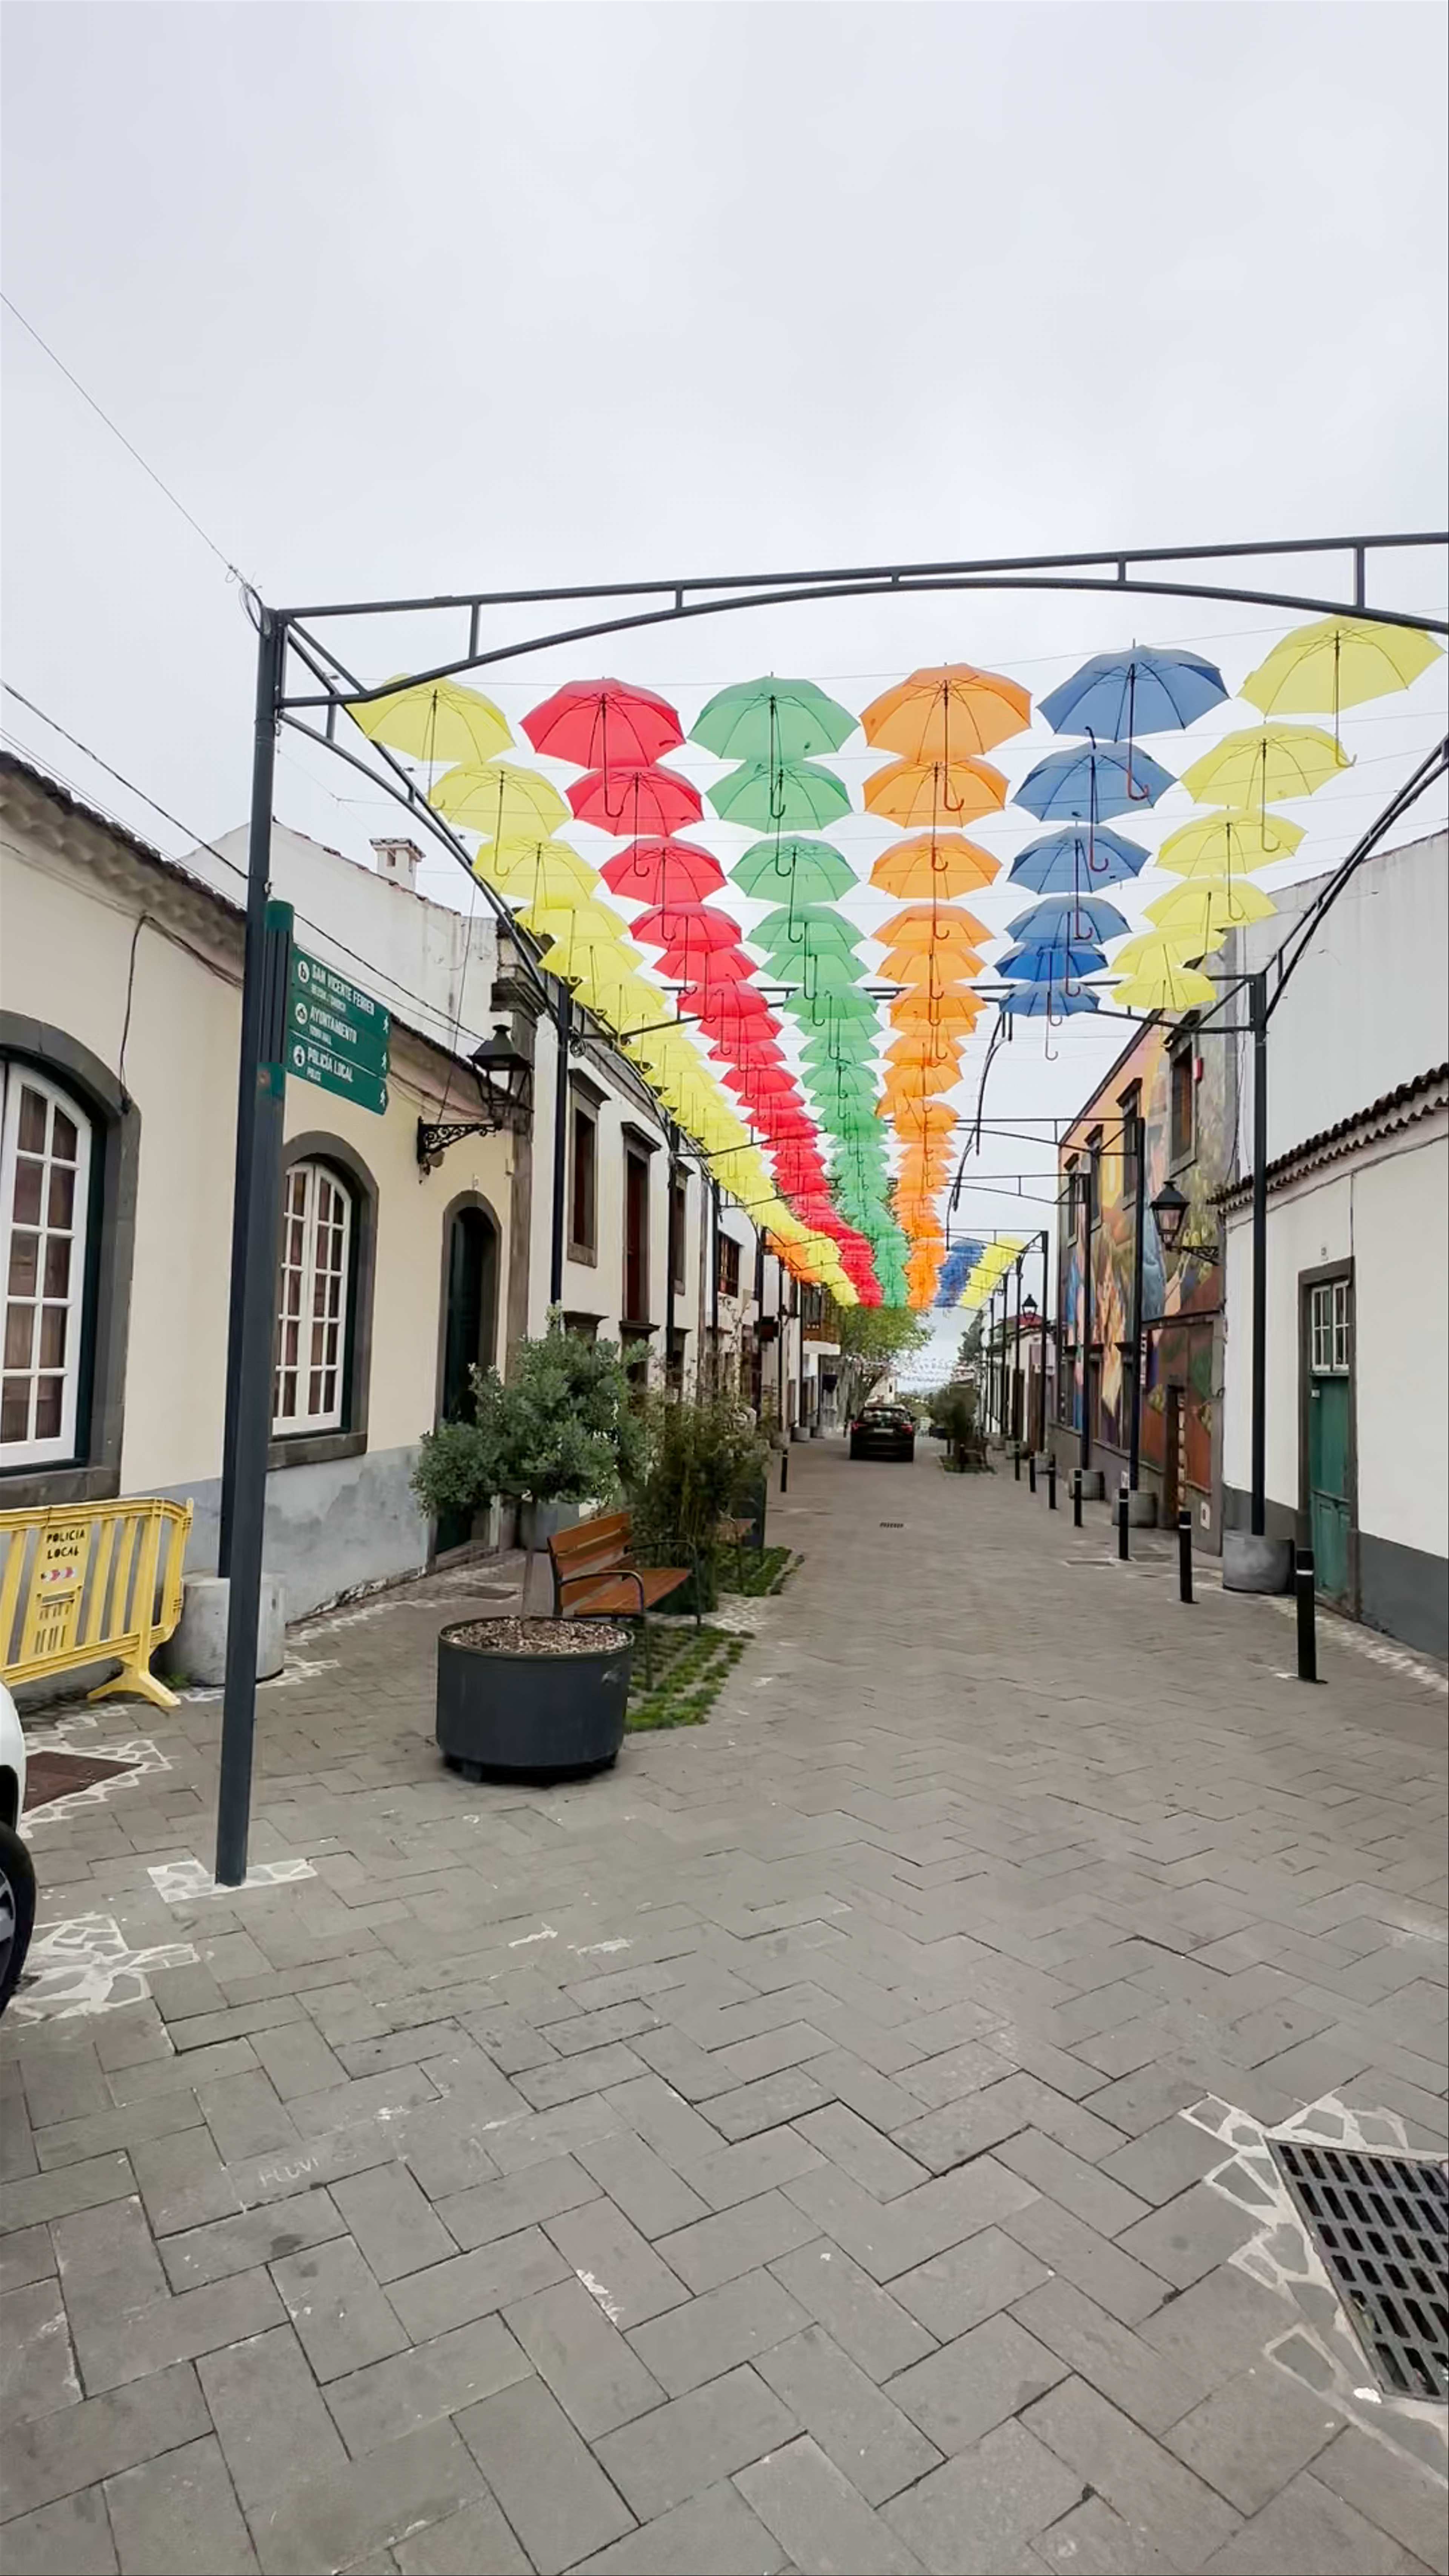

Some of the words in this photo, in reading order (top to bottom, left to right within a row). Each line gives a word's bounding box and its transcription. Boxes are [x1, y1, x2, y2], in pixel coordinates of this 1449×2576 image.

[312, 964, 326, 984] SAN
[328, 973, 352, 1001] VICENTE
[353, 990, 375, 1016] FERRER
[309, 1006, 357, 1044] AYUNTAMIENTO
[334, 1060, 354, 1083] LOCAL
[46, 1529, 85, 1544] POLICIA
[47, 1545, 79, 1559] LOCAL
